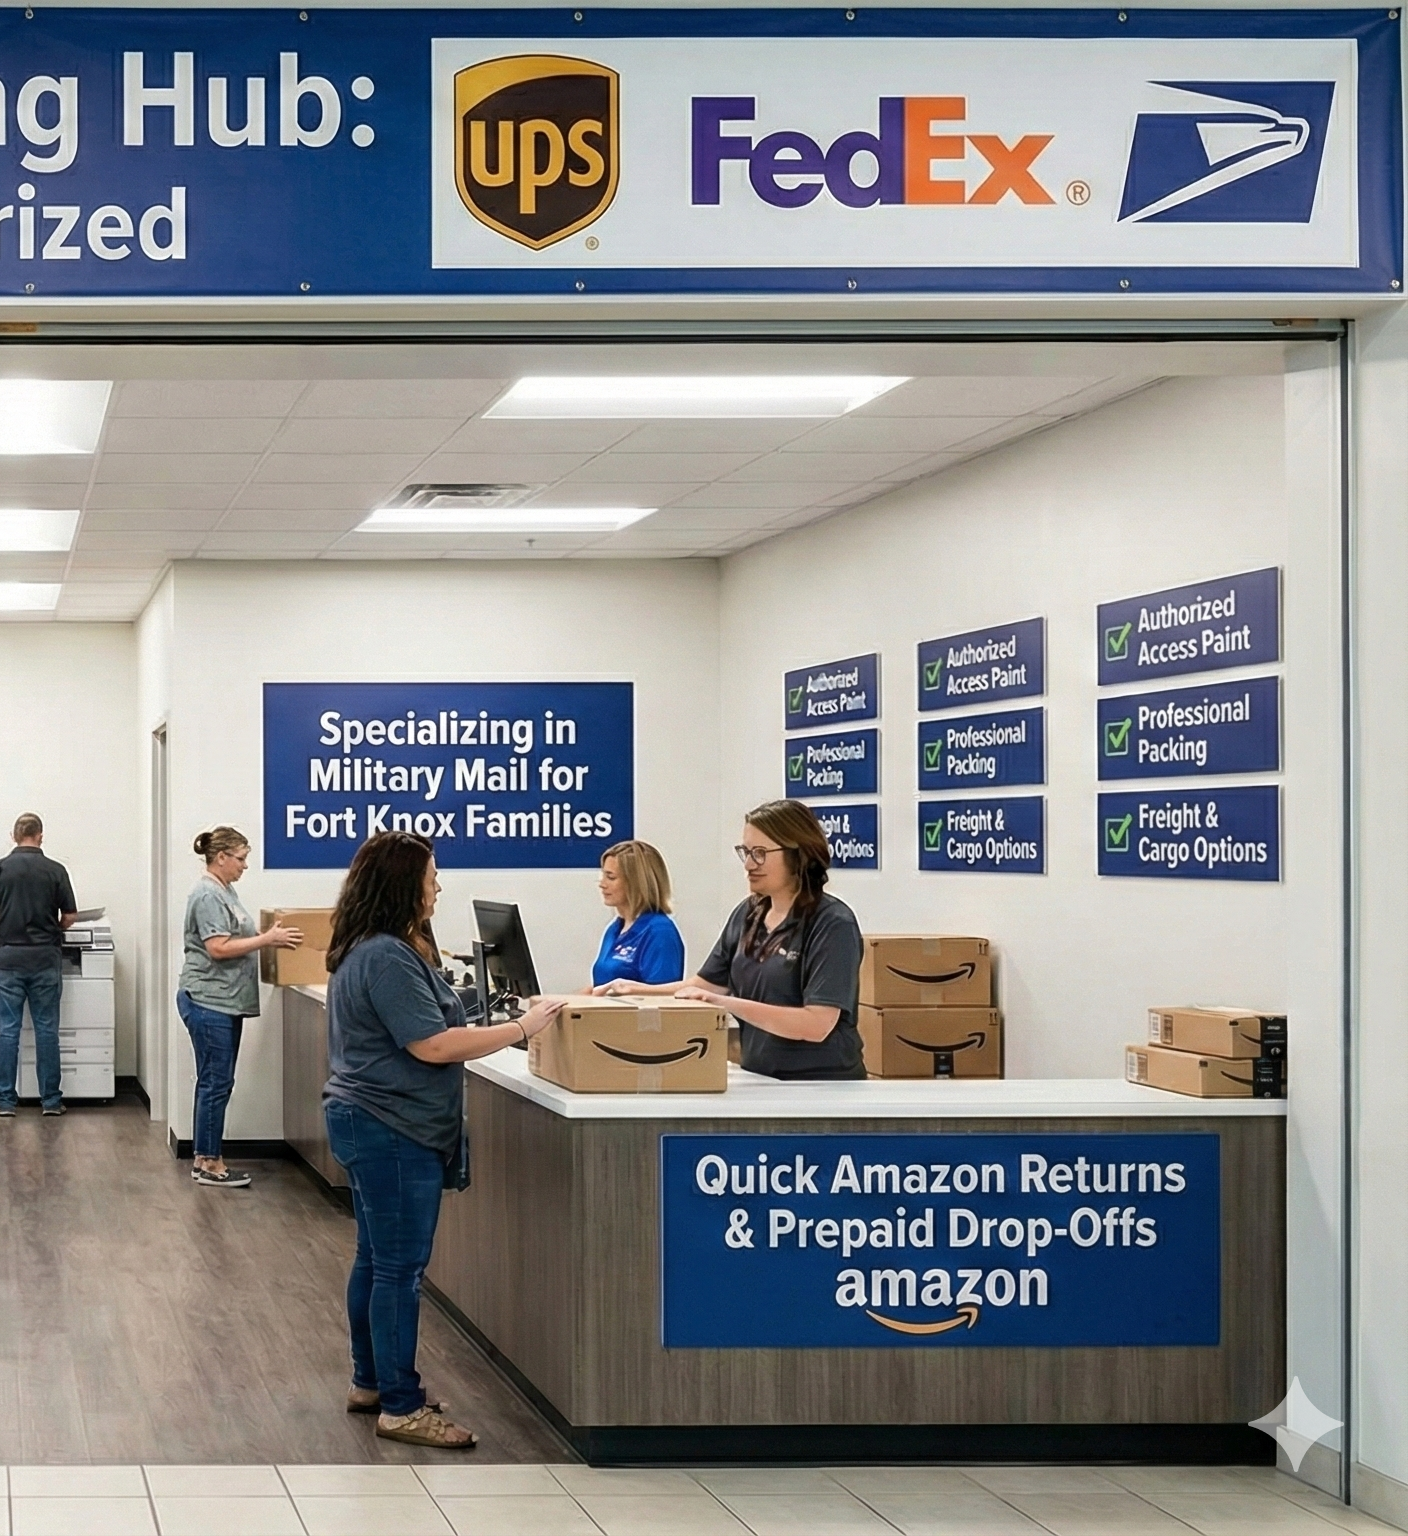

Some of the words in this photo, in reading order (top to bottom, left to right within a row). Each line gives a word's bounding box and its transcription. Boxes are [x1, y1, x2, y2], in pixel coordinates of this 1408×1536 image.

[125, 53, 375, 148] Hub:
[691, 95, 1057, 205] FedEx
[1138, 590, 1235, 633] Authorized
[946, 635, 1016, 668] Authorized
[1138, 638, 1198, 666] Access
[1201, 624, 1251, 656] Paint
[946, 672, 988, 696] Access
[991, 664, 1027, 688] Paint
[1138, 693, 1250, 730] Professional
[321, 711, 534, 755] Specializing
[546, 711, 577, 746] in
[947, 720, 1026, 749] Professional
[1138, 735, 1208, 766] Packing
[311, 758, 445, 801] Military
[456, 758, 528, 793] Mail
[539, 758, 589, 793] for
[947, 752, 996, 779] Packing
[287, 805, 357, 839] Fort
[368, 805, 456, 838] Knox
[467, 803, 612, 839] Families
[947, 810, 992, 837] Freight
[994, 808, 1005, 831] &
[1138, 802, 1201, 835] Freight
[1205, 801, 1219, 828] &
[946, 837, 983, 864] Cargo
[985, 836, 1037, 864] Options
[1138, 837, 1190, 869] Cargo
[1194, 836, 1267, 869] Options
[696, 1154, 820, 1197] Quick
[831, 1155, 1006, 1195] Amazon
[1021, 1154, 1187, 1195] Returns
[725, 1209, 756, 1250] &
[770, 1207, 935, 1258] Prepaid
[950, 1206, 1158, 1258] Drop-Offs
[836, 1269, 1049, 1308] amazon
